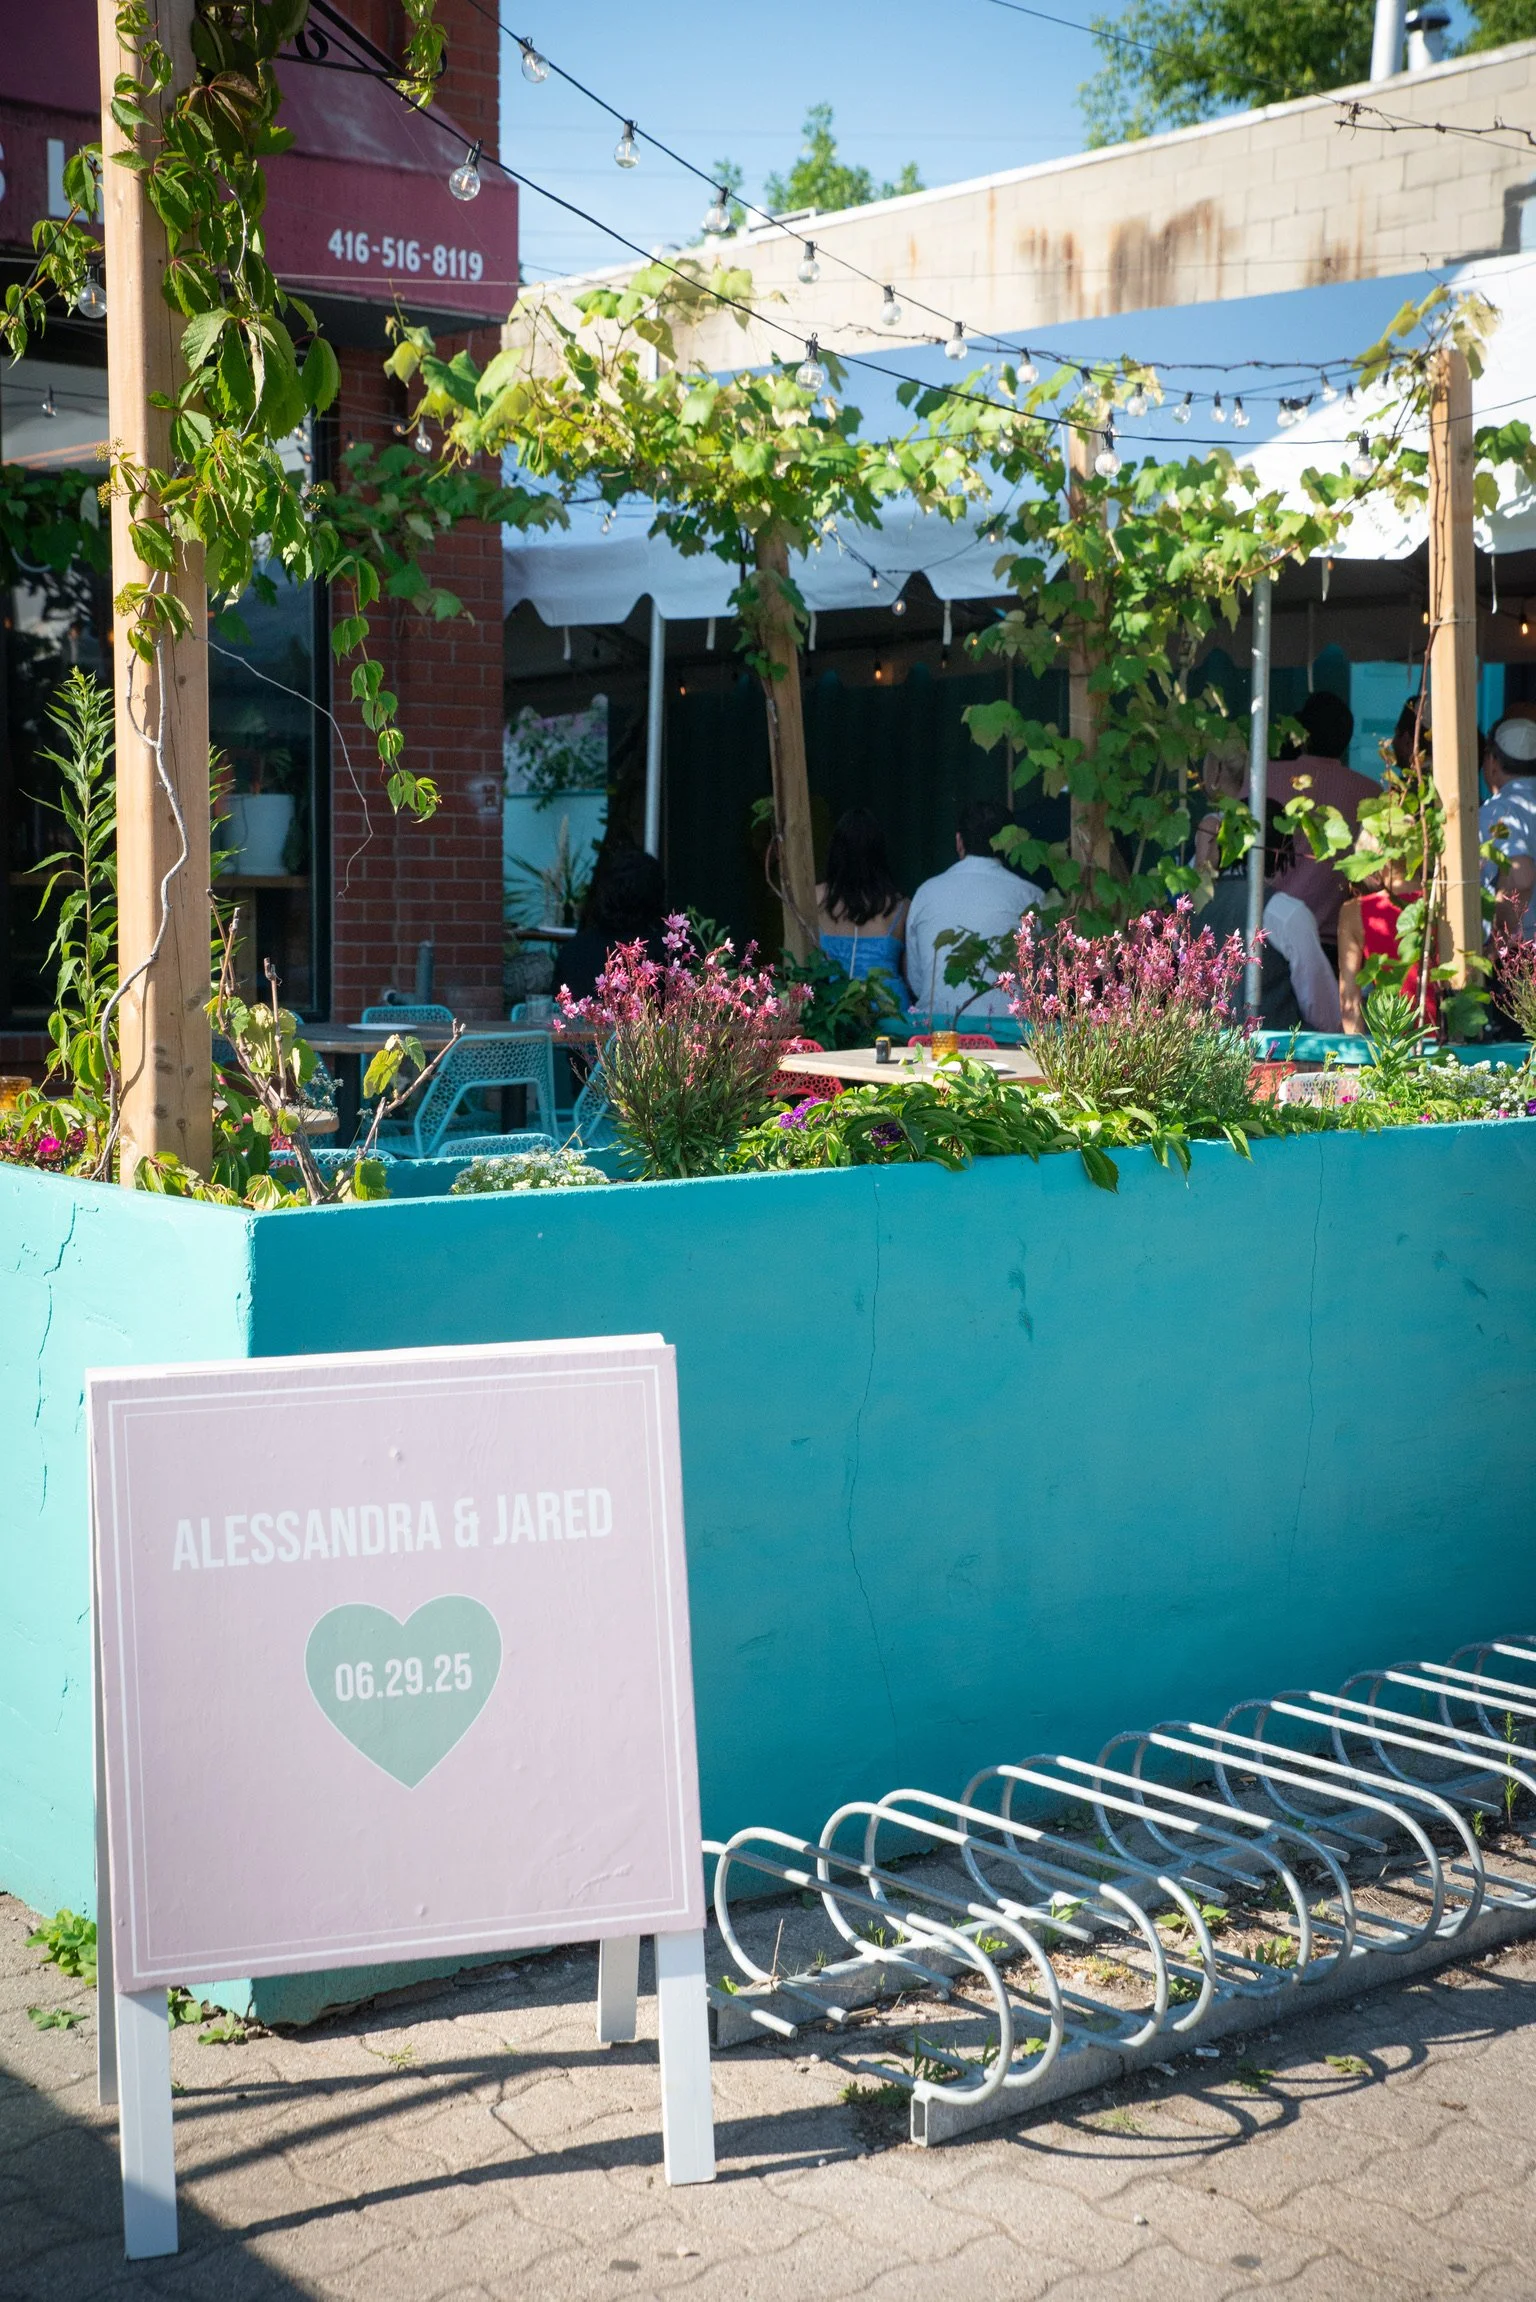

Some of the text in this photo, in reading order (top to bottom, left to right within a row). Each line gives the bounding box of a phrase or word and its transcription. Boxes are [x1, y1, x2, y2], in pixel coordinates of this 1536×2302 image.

[328, 228, 484, 281] 416-516-8119
[172, 1487, 613, 1571] ALESSANDRA & JARED
[335, 1652, 473, 1702] 06.29.25
